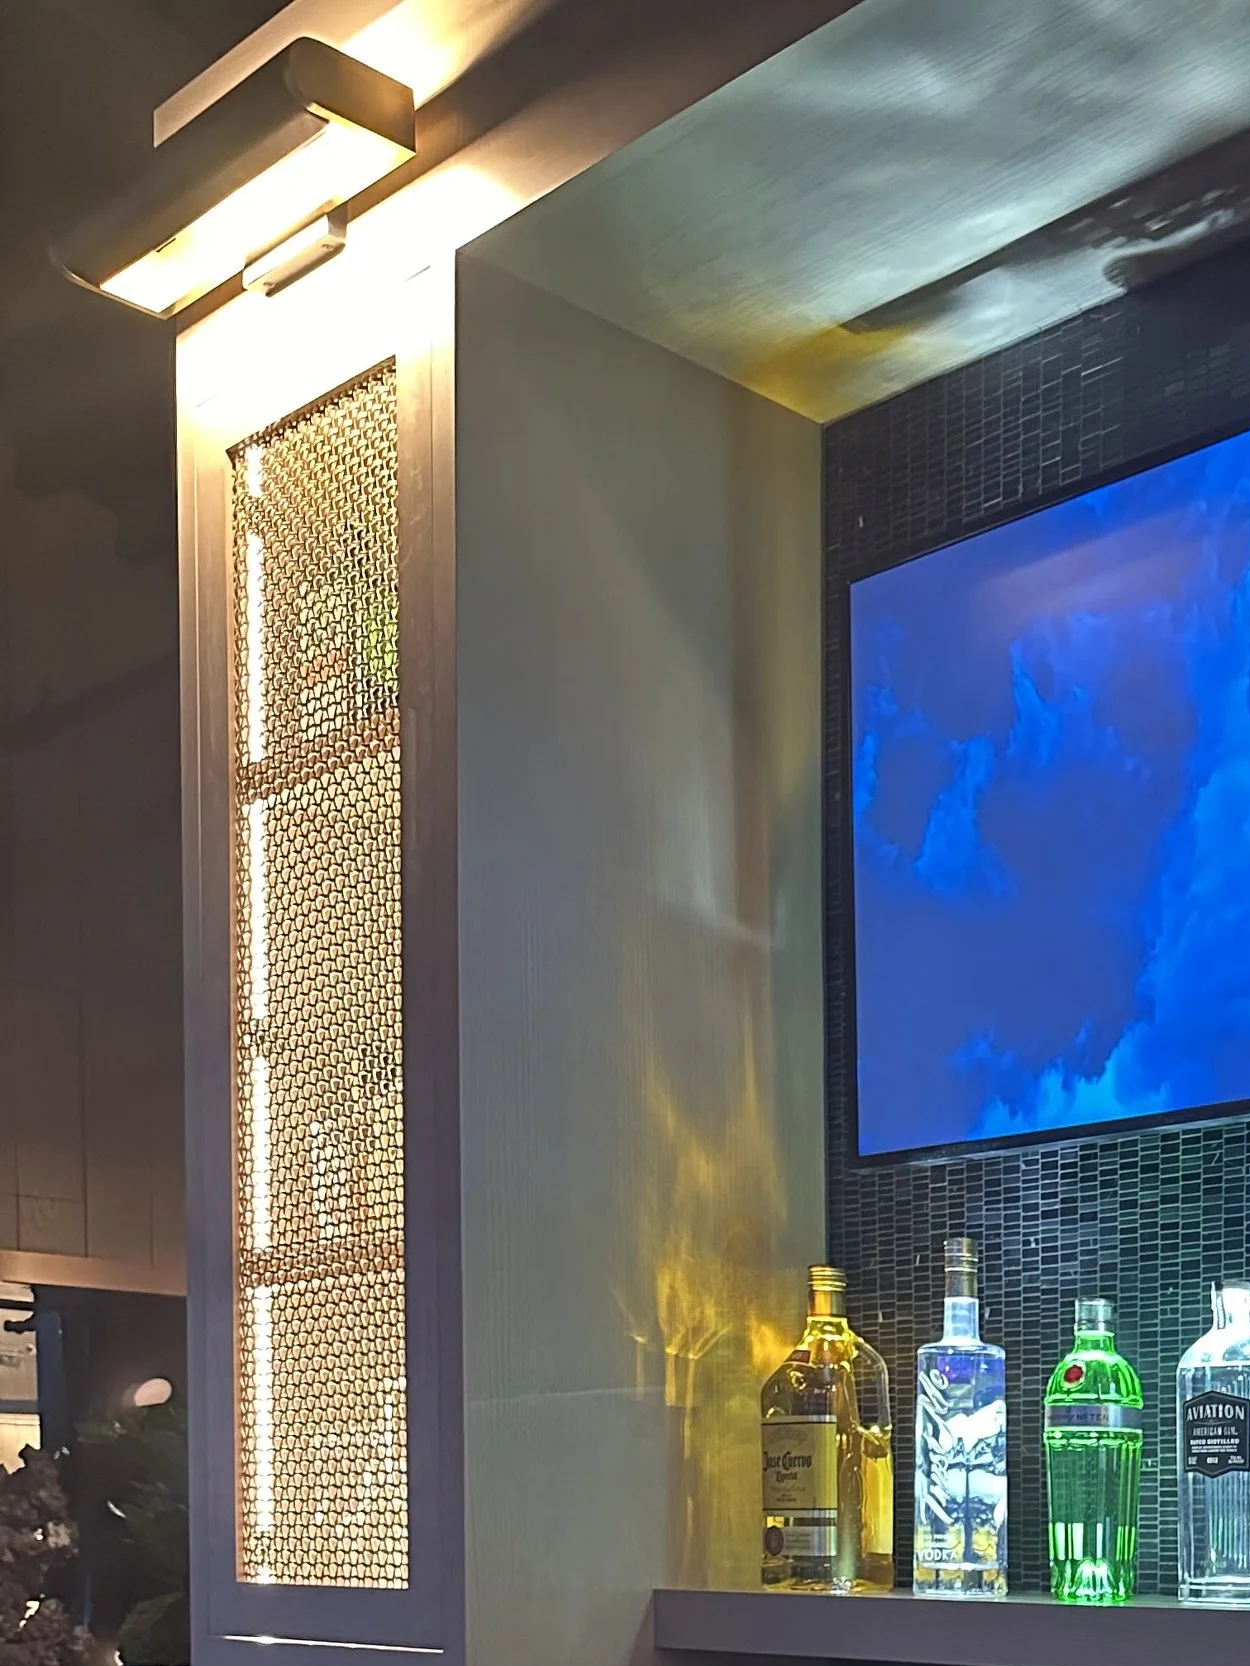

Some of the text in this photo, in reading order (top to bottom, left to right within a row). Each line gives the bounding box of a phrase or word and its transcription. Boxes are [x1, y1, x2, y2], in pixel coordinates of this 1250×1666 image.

[1186, 1404, 1245, 1421] AVIATION
[782, 1451, 812, 1471] Cuervo
[916, 1549, 958, 1562] VODKA
